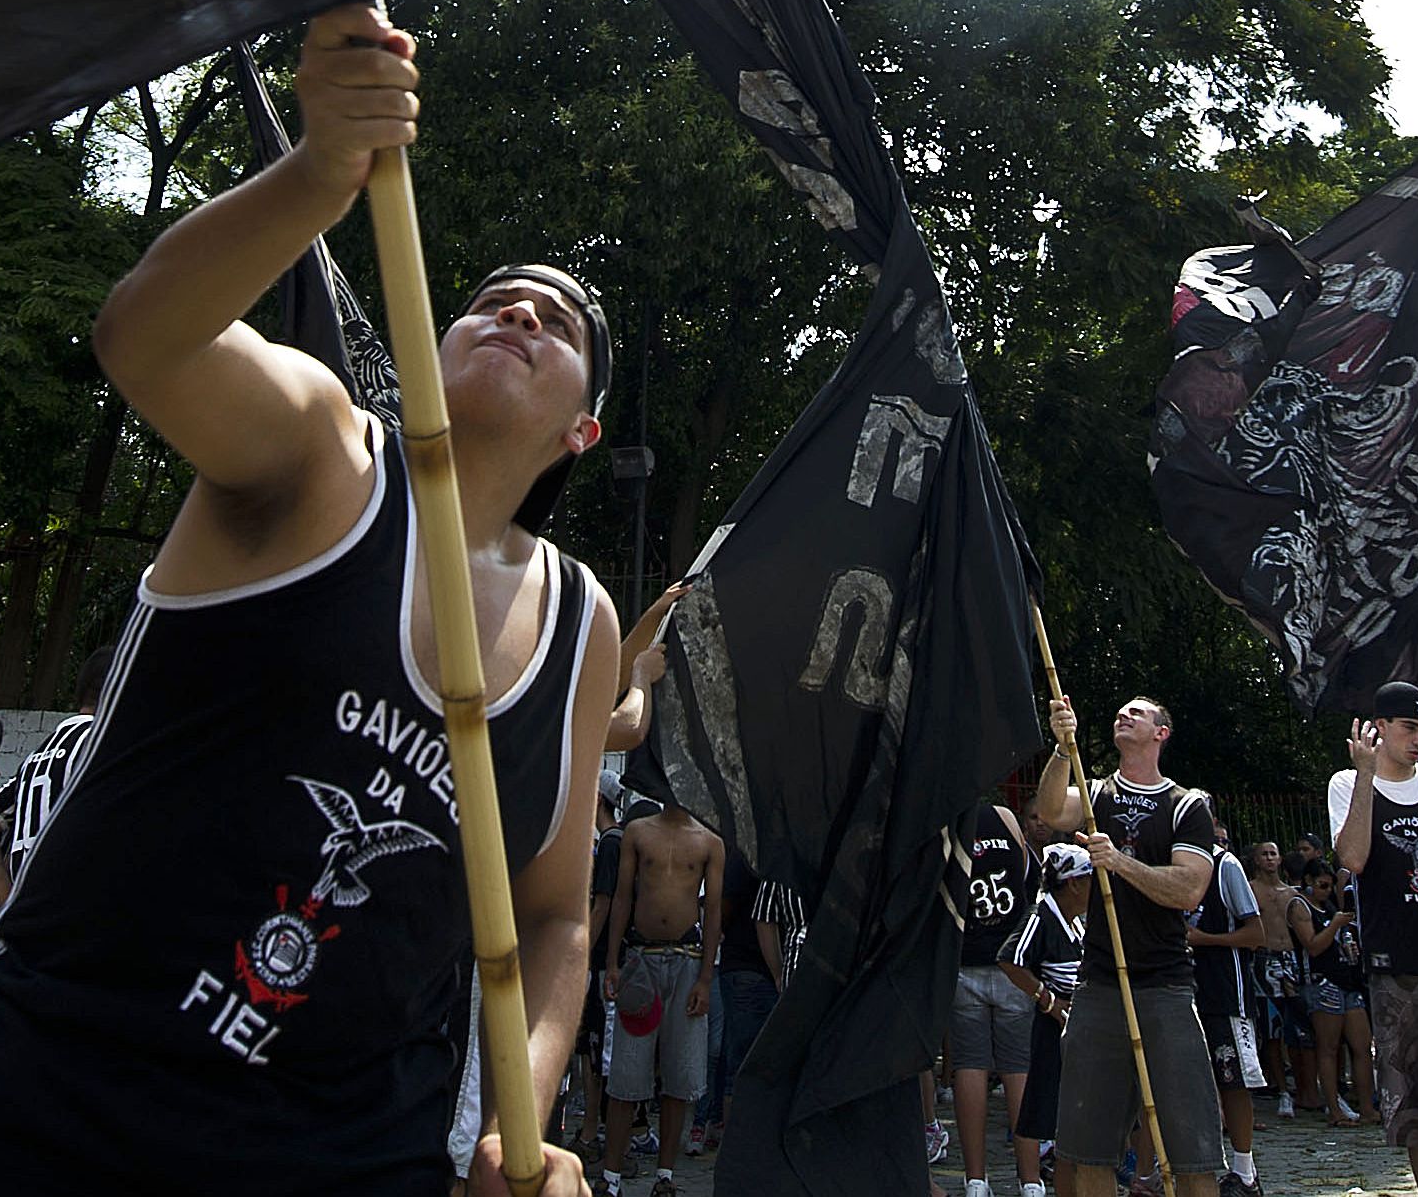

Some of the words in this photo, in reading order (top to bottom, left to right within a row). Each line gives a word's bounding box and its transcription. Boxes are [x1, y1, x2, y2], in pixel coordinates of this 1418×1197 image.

[335, 690, 461, 827] GAVIÕE
[365, 767, 407, 816] DA
[1113, 793, 1158, 811] GAVIÕES
[1128, 807, 1139, 815] DA
[1404, 829, 1418, 838] DA
[969, 869, 1015, 919] 35
[180, 969, 280, 1066] FIEL
